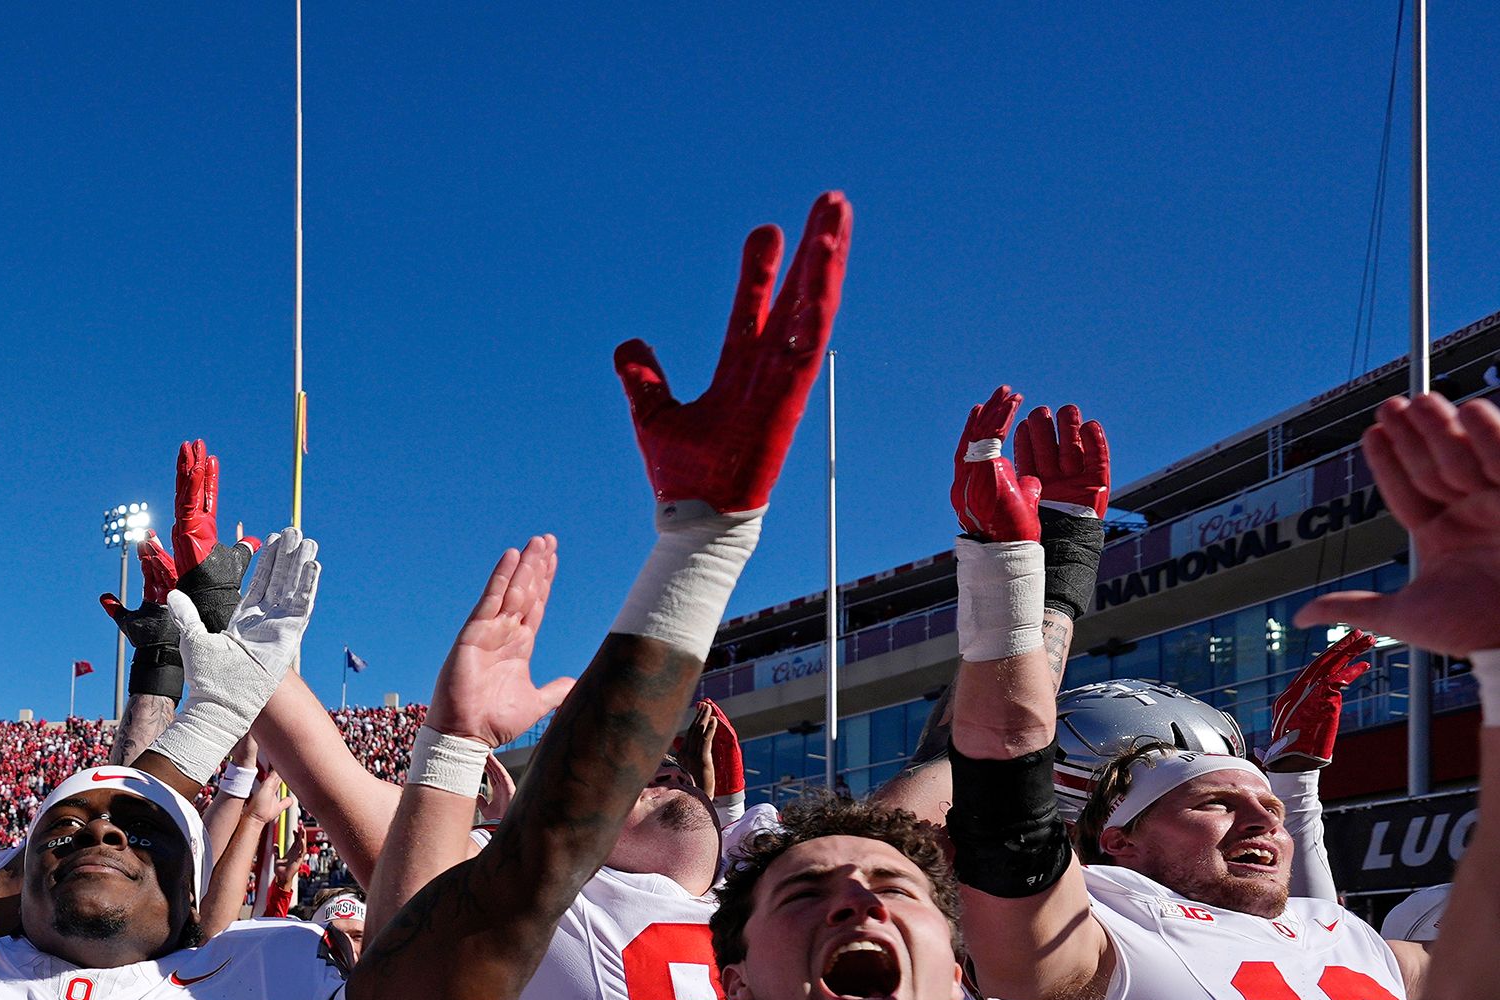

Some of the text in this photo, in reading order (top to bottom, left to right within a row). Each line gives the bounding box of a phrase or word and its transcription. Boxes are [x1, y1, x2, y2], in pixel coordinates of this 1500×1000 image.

[1361, 354, 1410, 384] TERRA
[1200, 499, 1279, 547] Coors
[1096, 529, 1292, 611] NATIONAL
